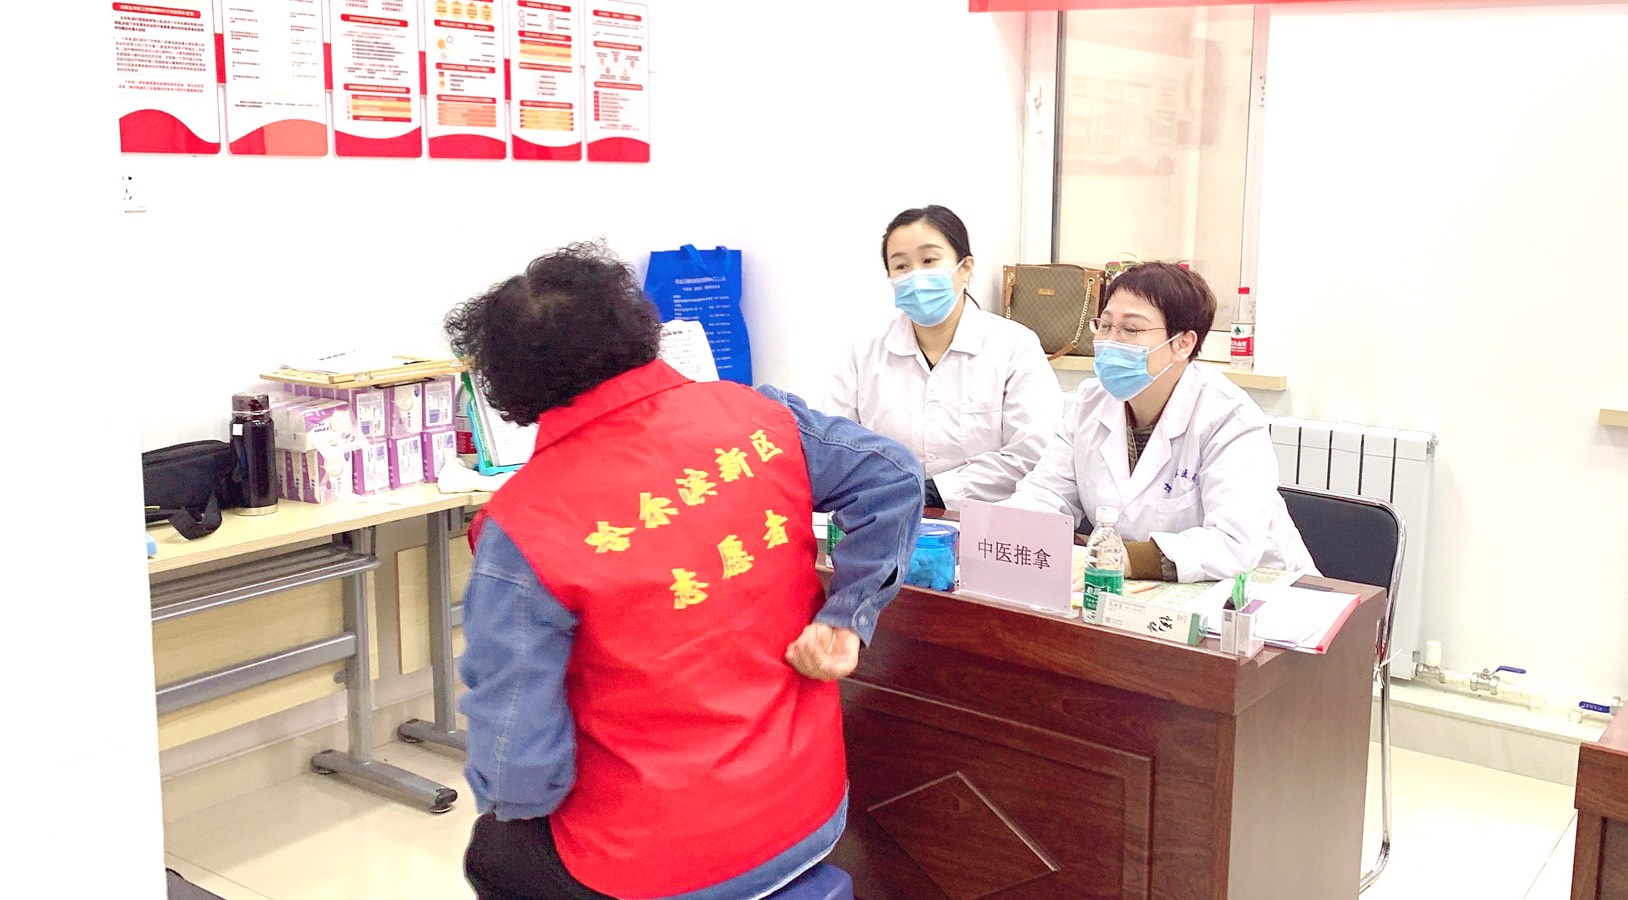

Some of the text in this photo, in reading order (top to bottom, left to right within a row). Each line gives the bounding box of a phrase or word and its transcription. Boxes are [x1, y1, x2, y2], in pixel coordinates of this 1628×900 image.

[586, 428, 783, 554] 哈尔滨新区
[669, 509, 789, 610] 志愿者
[977, 538, 1051, 570] 中医推拿
